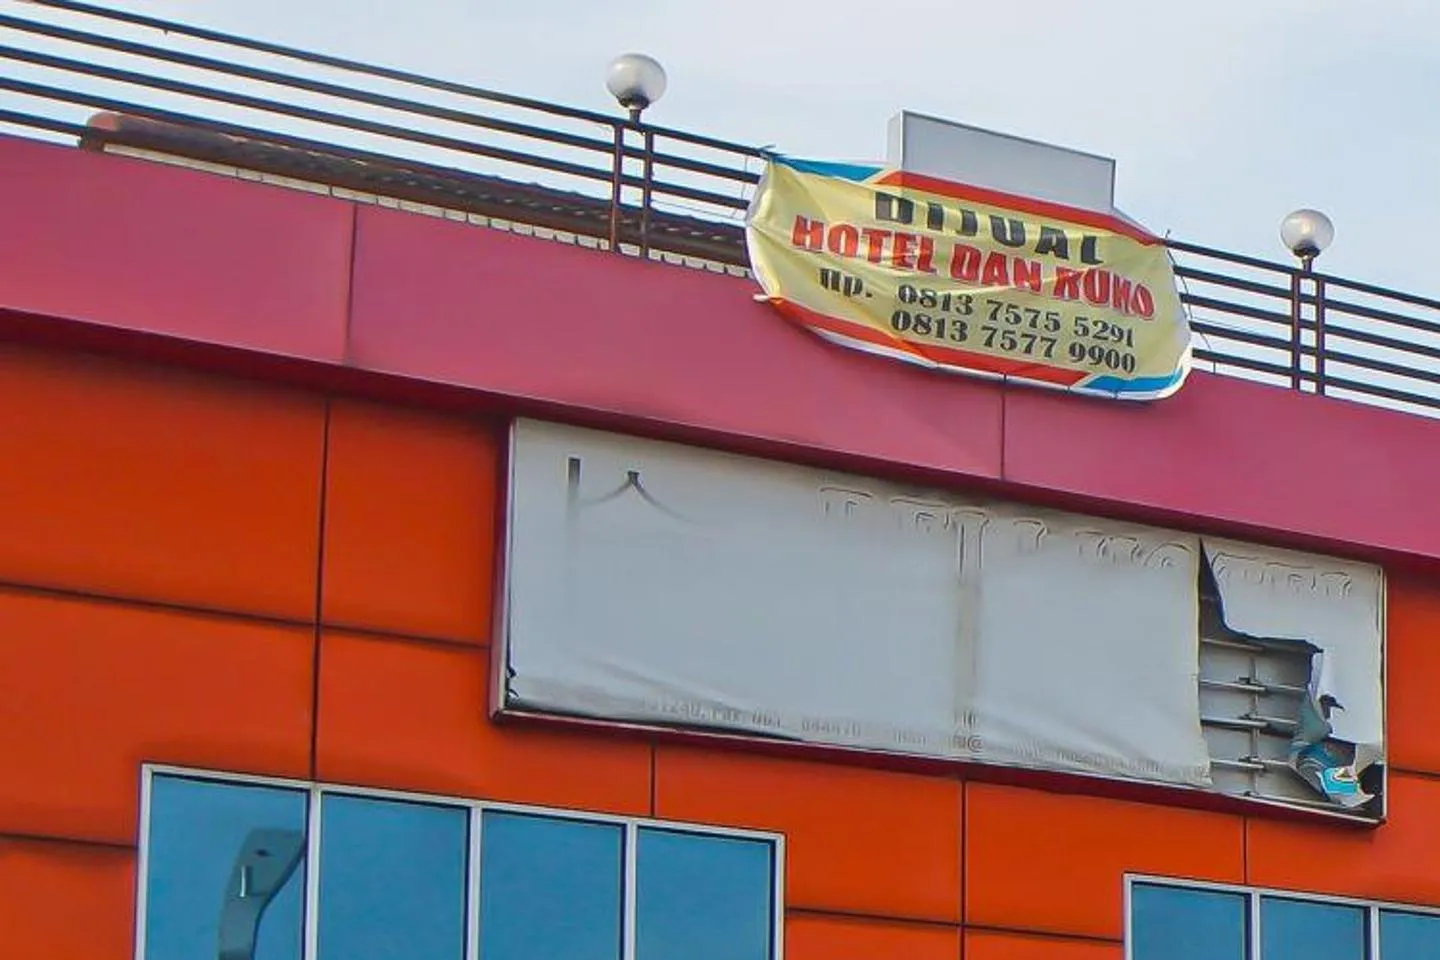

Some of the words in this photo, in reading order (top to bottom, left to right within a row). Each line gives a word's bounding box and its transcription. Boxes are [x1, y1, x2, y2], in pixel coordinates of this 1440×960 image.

[875, 191, 1104, 265] DIJUAL
[792, 214, 939, 276] HOTEL
[950, 243, 1042, 295] DAN
[1053, 266, 1156, 318] RUKO
[891, 310, 969, 343] 0813
[981, 325, 1058, 359] 7577
[1068, 341, 1137, 374] 9900
[898, 284, 974, 316] 0813
[986, 299, 1062, 333] 7575
[1073, 316, 1135, 348] 5291
